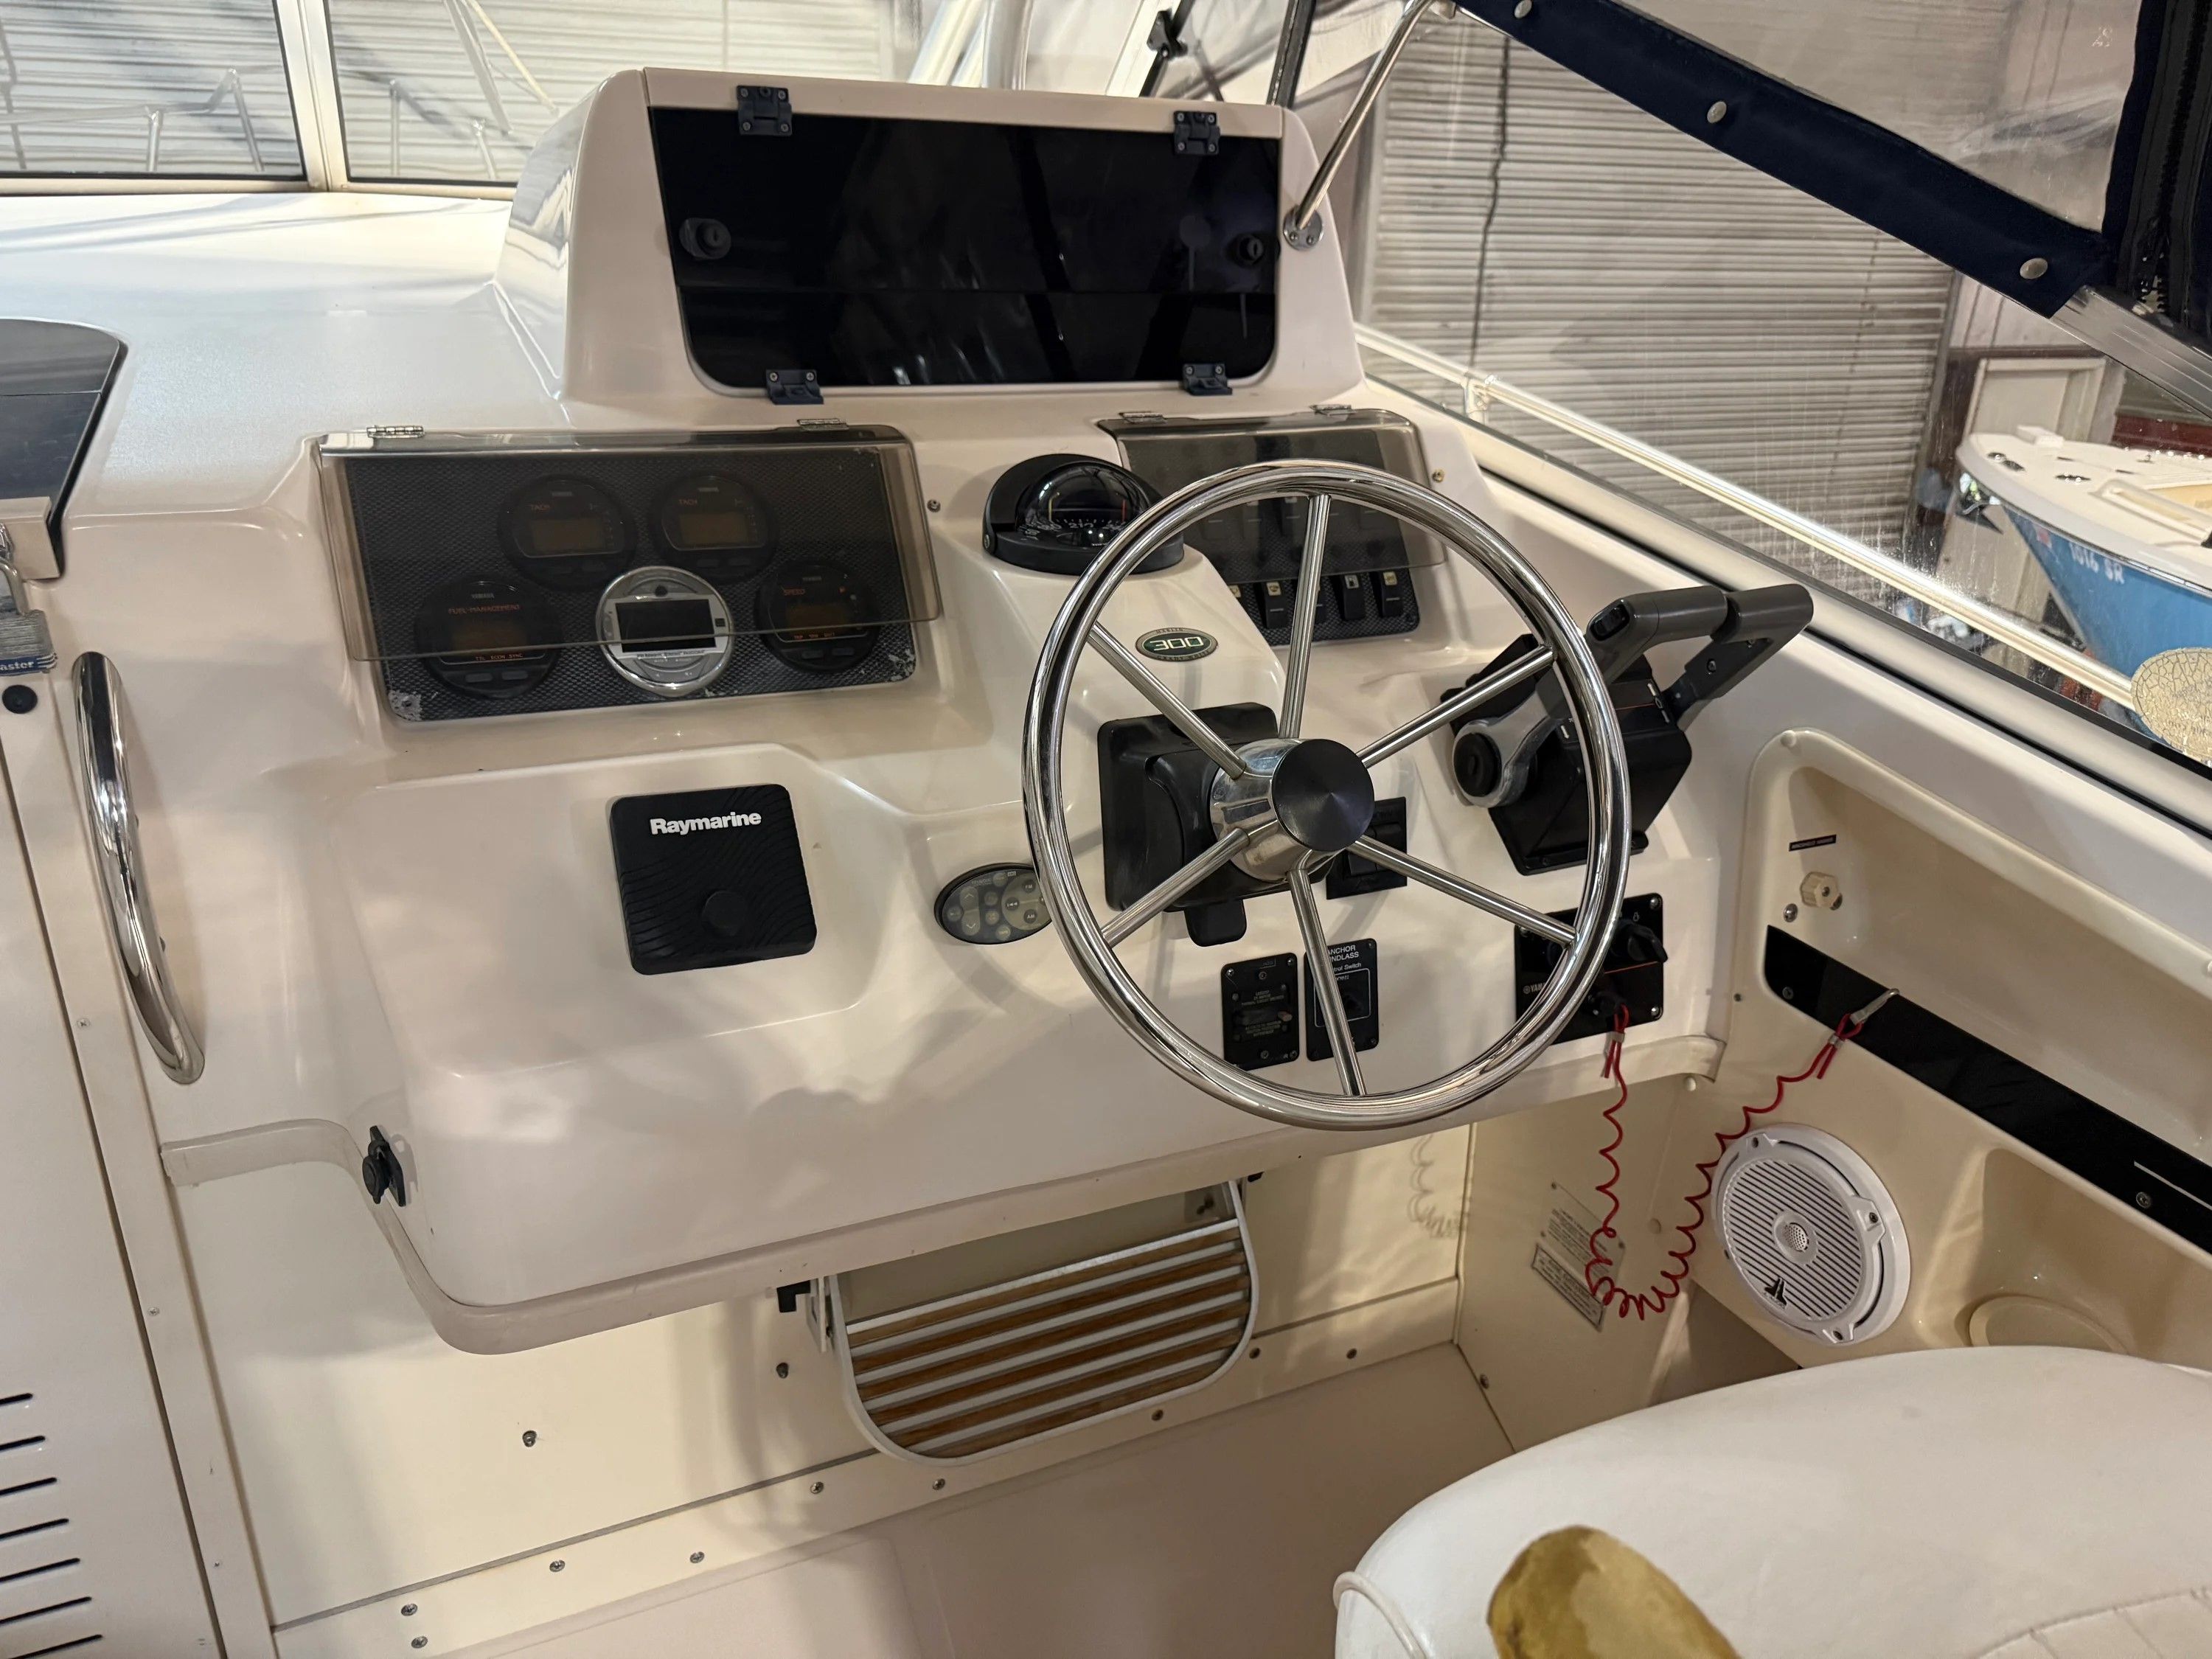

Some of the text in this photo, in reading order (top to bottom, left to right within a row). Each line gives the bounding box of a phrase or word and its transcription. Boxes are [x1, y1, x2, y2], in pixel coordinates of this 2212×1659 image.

[1150, 636, 1204, 651] 300
[0, 661, 34, 671] aster
[650, 811, 762, 835] Raymarine
[1330, 951, 1359, 962] NDLASS
[1344, 962, 1362, 970] Switch
